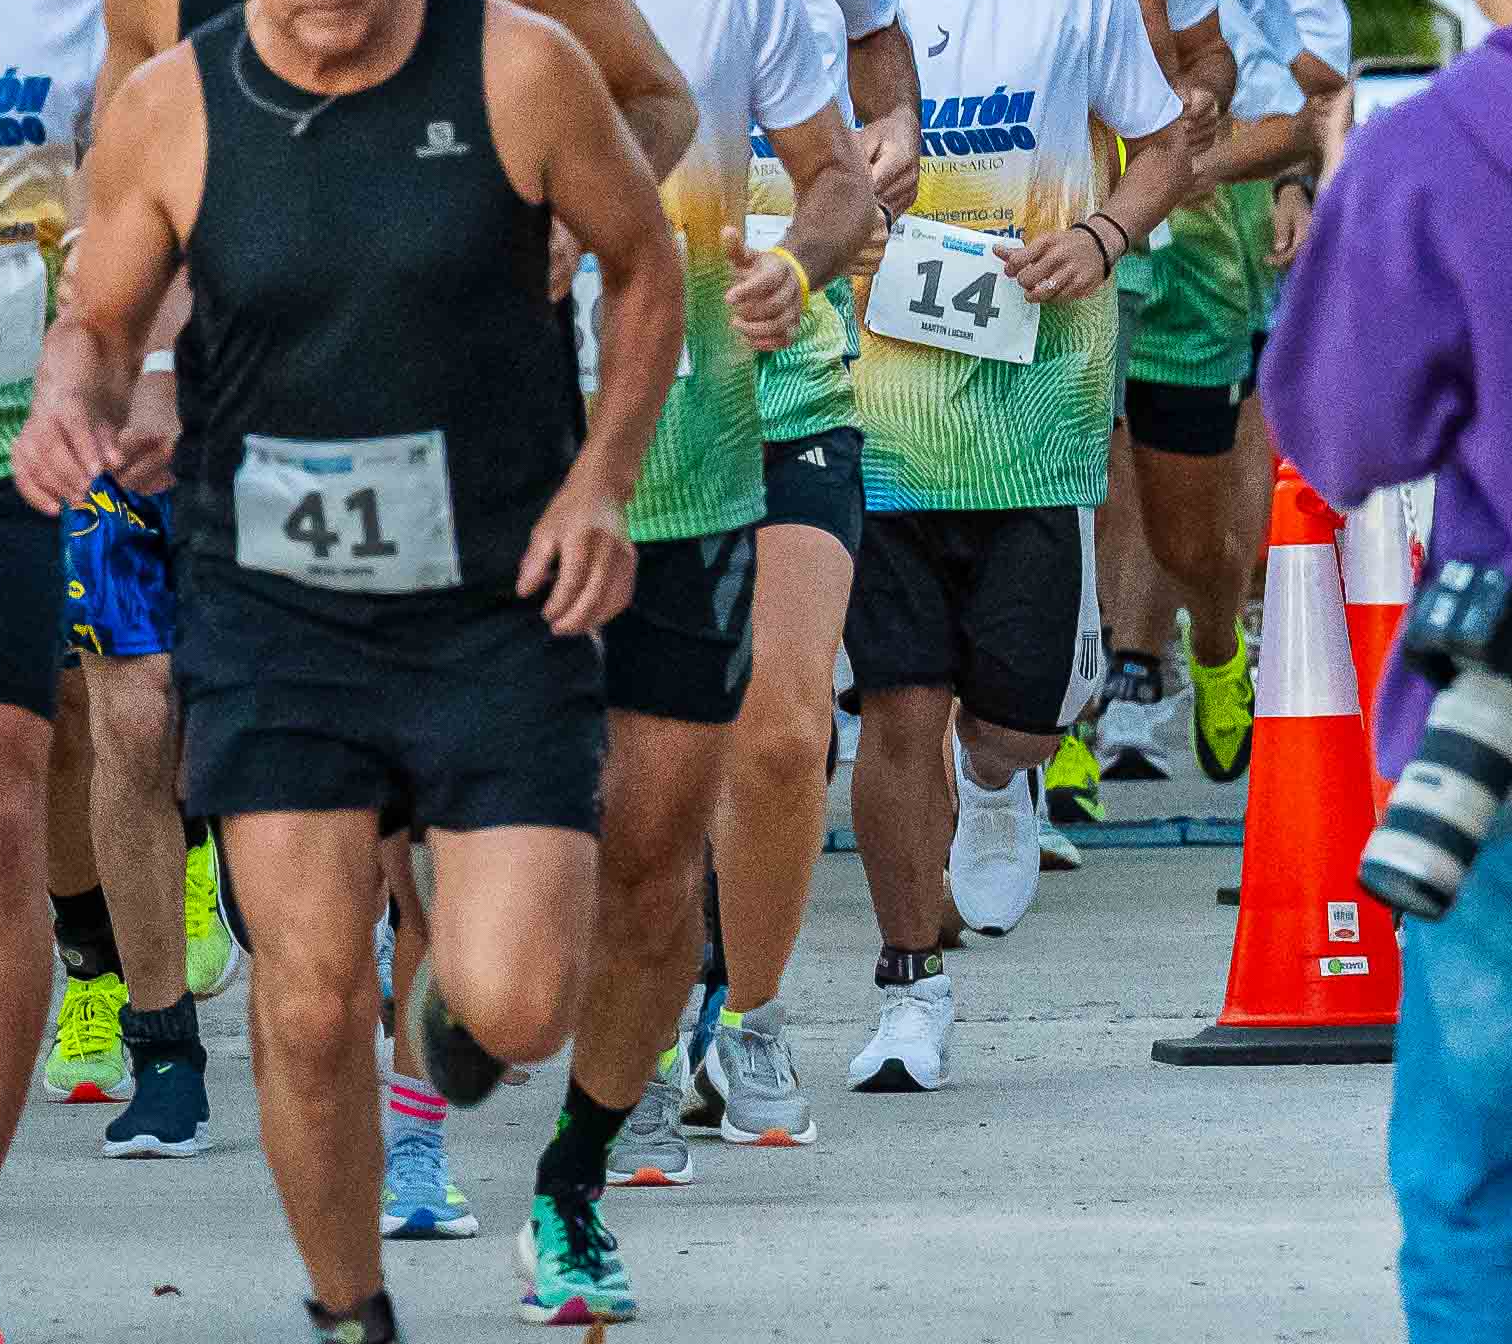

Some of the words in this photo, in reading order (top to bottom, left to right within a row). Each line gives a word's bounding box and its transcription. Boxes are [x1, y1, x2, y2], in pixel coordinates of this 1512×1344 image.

[921, 85, 1036, 129] RATÓN
[921, 125, 1037, 157] TONDO
[920, 158, 1005, 175] NIVERSARIO
[914, 207, 992, 223] obierno
[908, 259, 1001, 329] 14
[284, 489, 399, 558] 41
